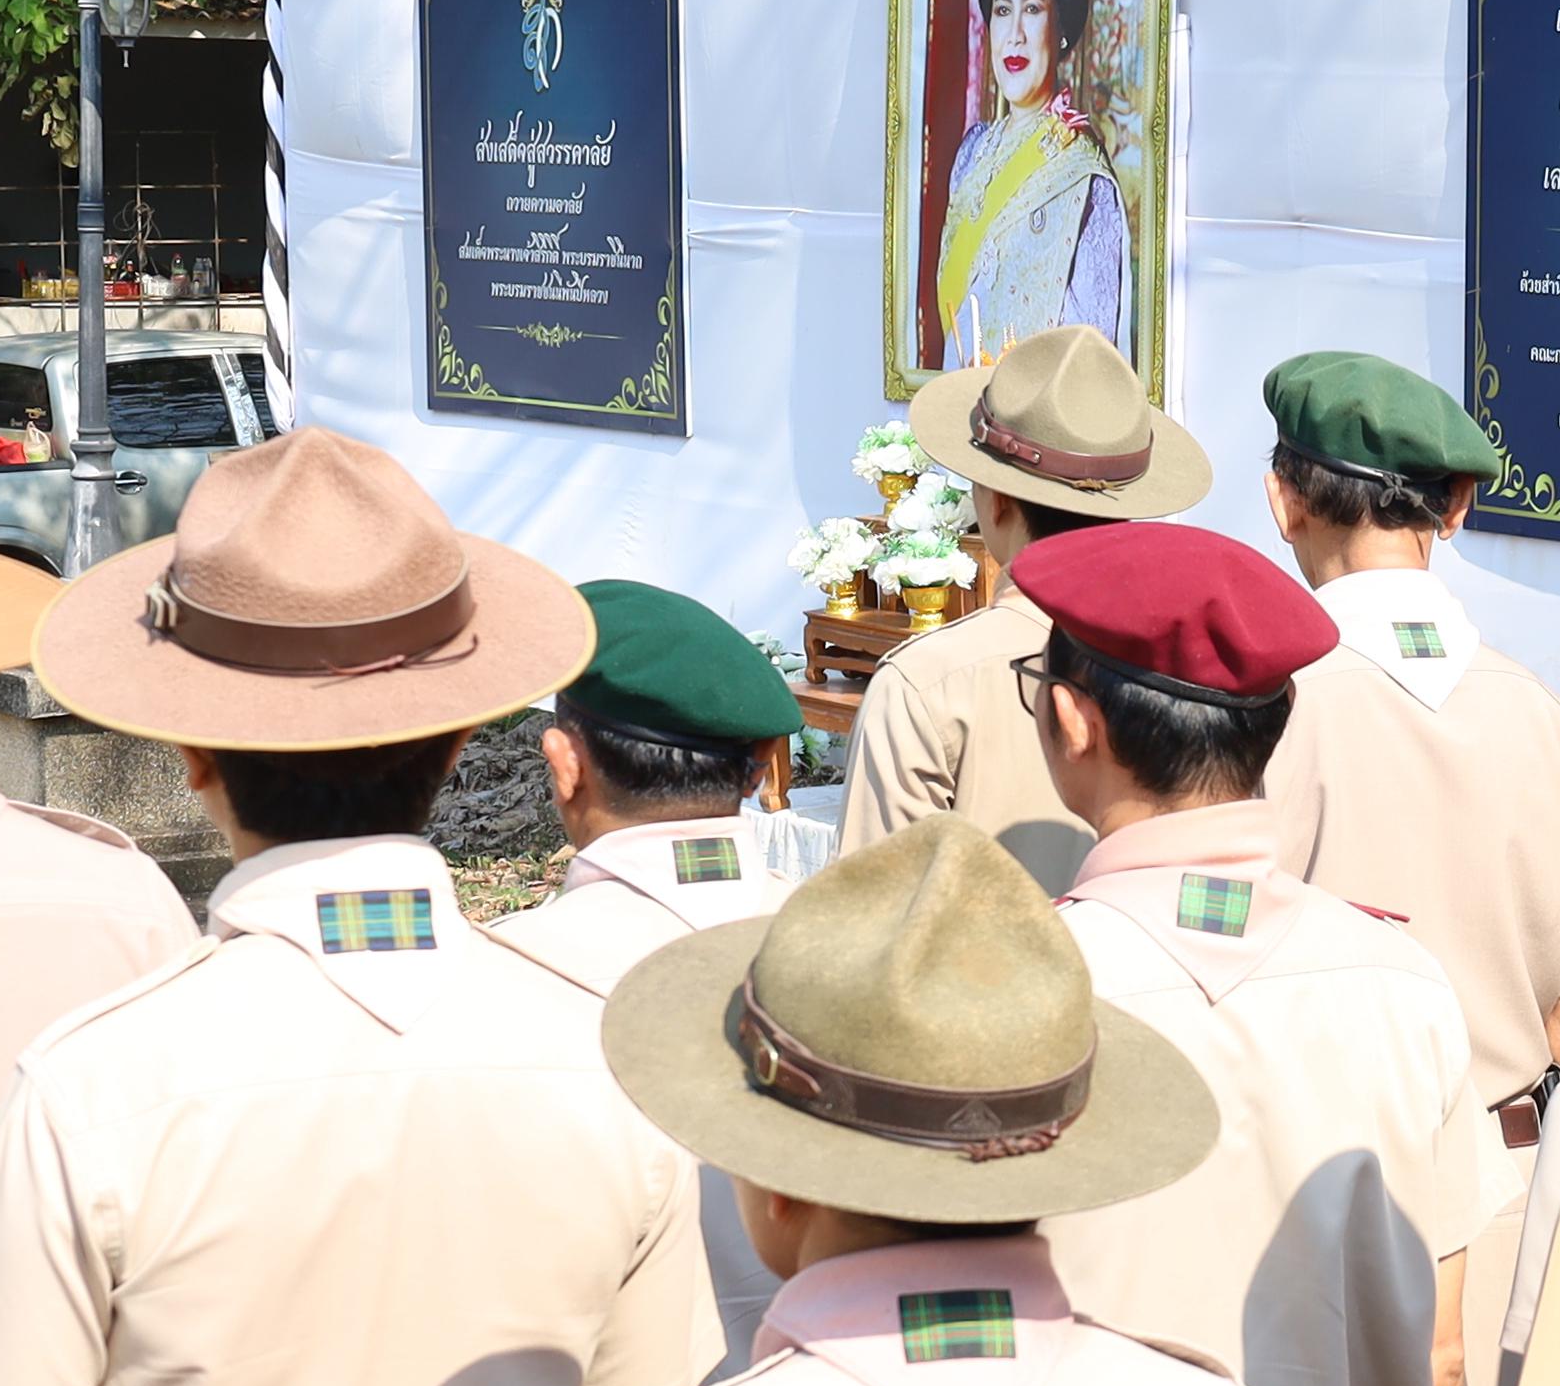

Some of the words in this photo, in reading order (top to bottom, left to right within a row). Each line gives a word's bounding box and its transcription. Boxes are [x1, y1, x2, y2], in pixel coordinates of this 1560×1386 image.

[475, 110, 616, 189] ส่งเสด็จสู่สวรรคาลัย
[506, 182, 586, 215] ถวายความอาลัย
